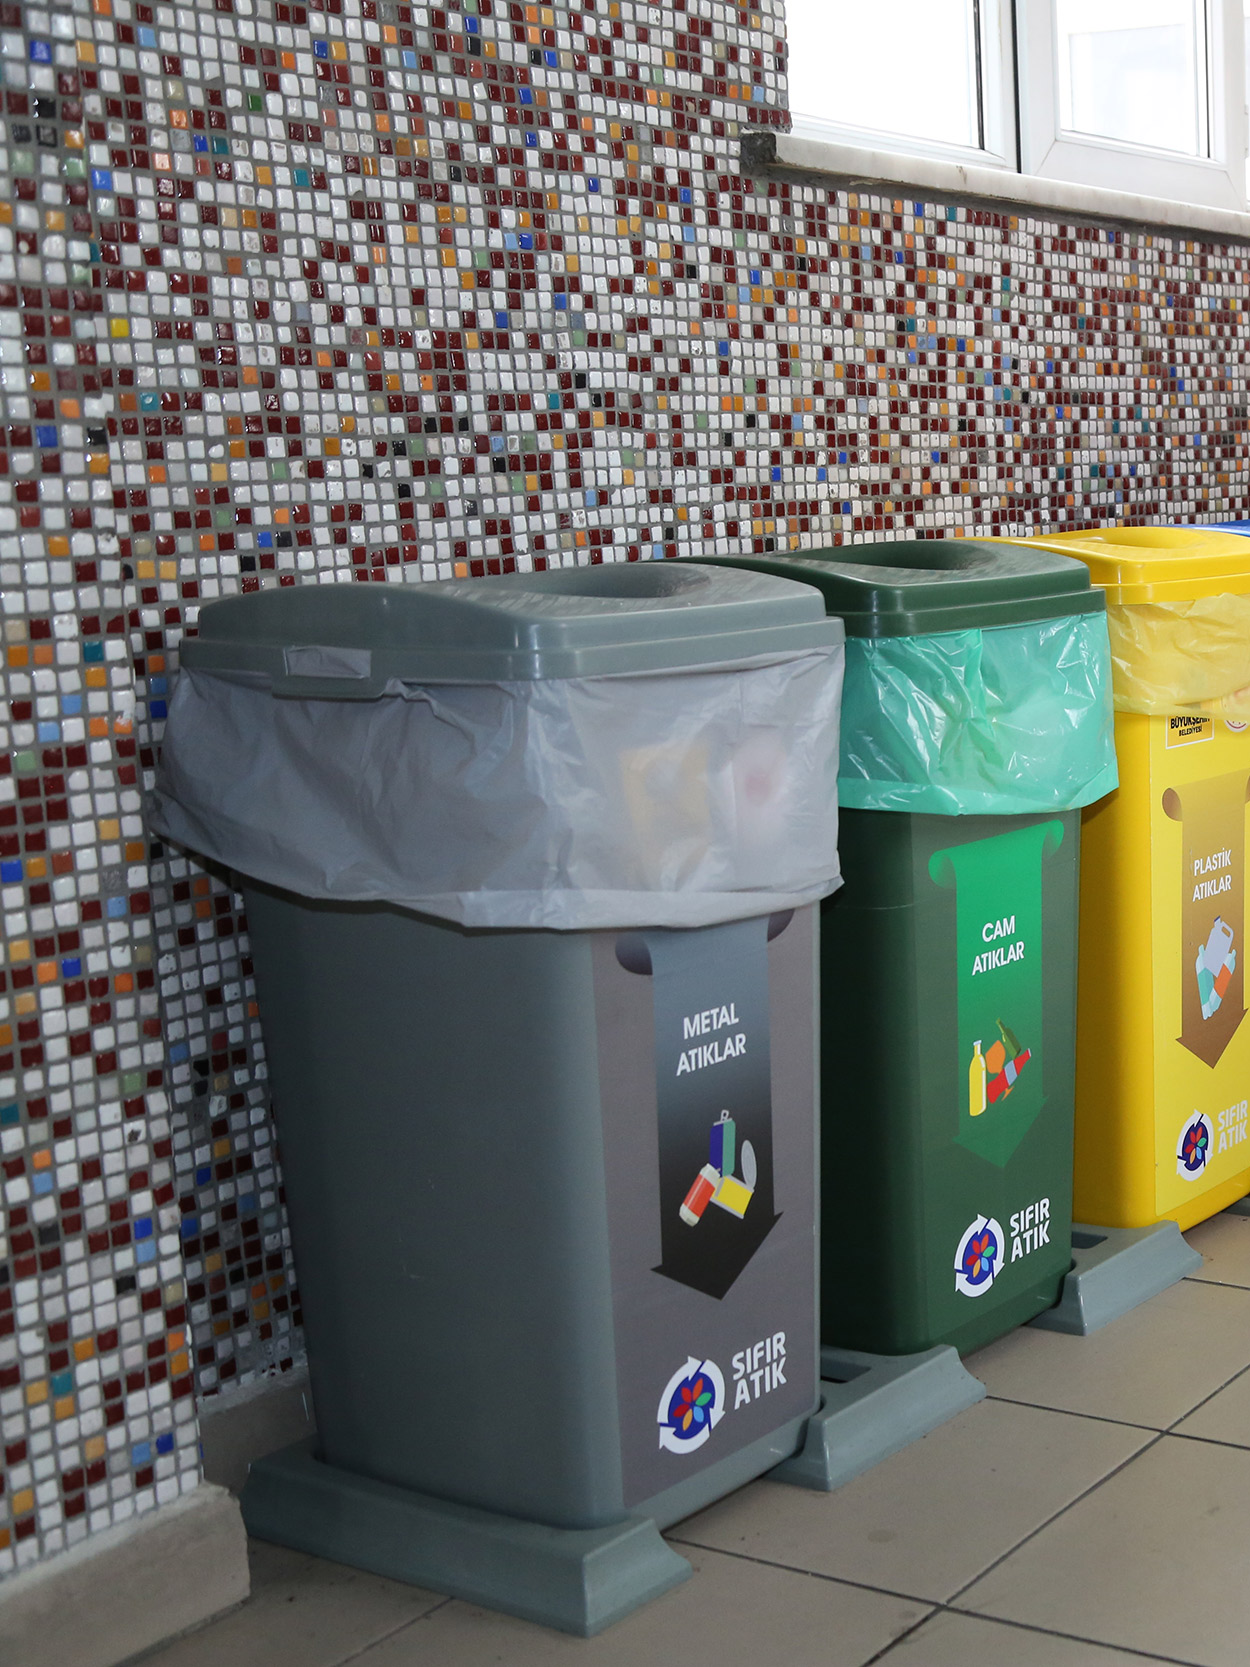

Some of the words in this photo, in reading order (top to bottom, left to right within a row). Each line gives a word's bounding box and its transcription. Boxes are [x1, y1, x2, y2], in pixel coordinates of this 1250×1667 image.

[1170, 716, 1210, 729] BÜYÜKŞE
[1178, 724, 1203, 736] BELEDİYESİ
[1194, 847, 1232, 877] PLASTİK
[1192, 874, 1232, 902] ATIKLAR
[982, 915, 1015, 942] CAM
[971, 941, 1025, 976] ATIKLAR
[683, 1002, 739, 1040] METAL
[676, 1033, 746, 1076] ATIKLAR
[1217, 1099, 1248, 1131] SIFIR
[1217, 1119, 1248, 1154] ATIK
[1009, 1197, 1050, 1238] SIFIR
[1010, 1219, 1050, 1263] ATIK
[731, 1331, 786, 1380] SIFIR
[733, 1356, 787, 1410] ATIK
